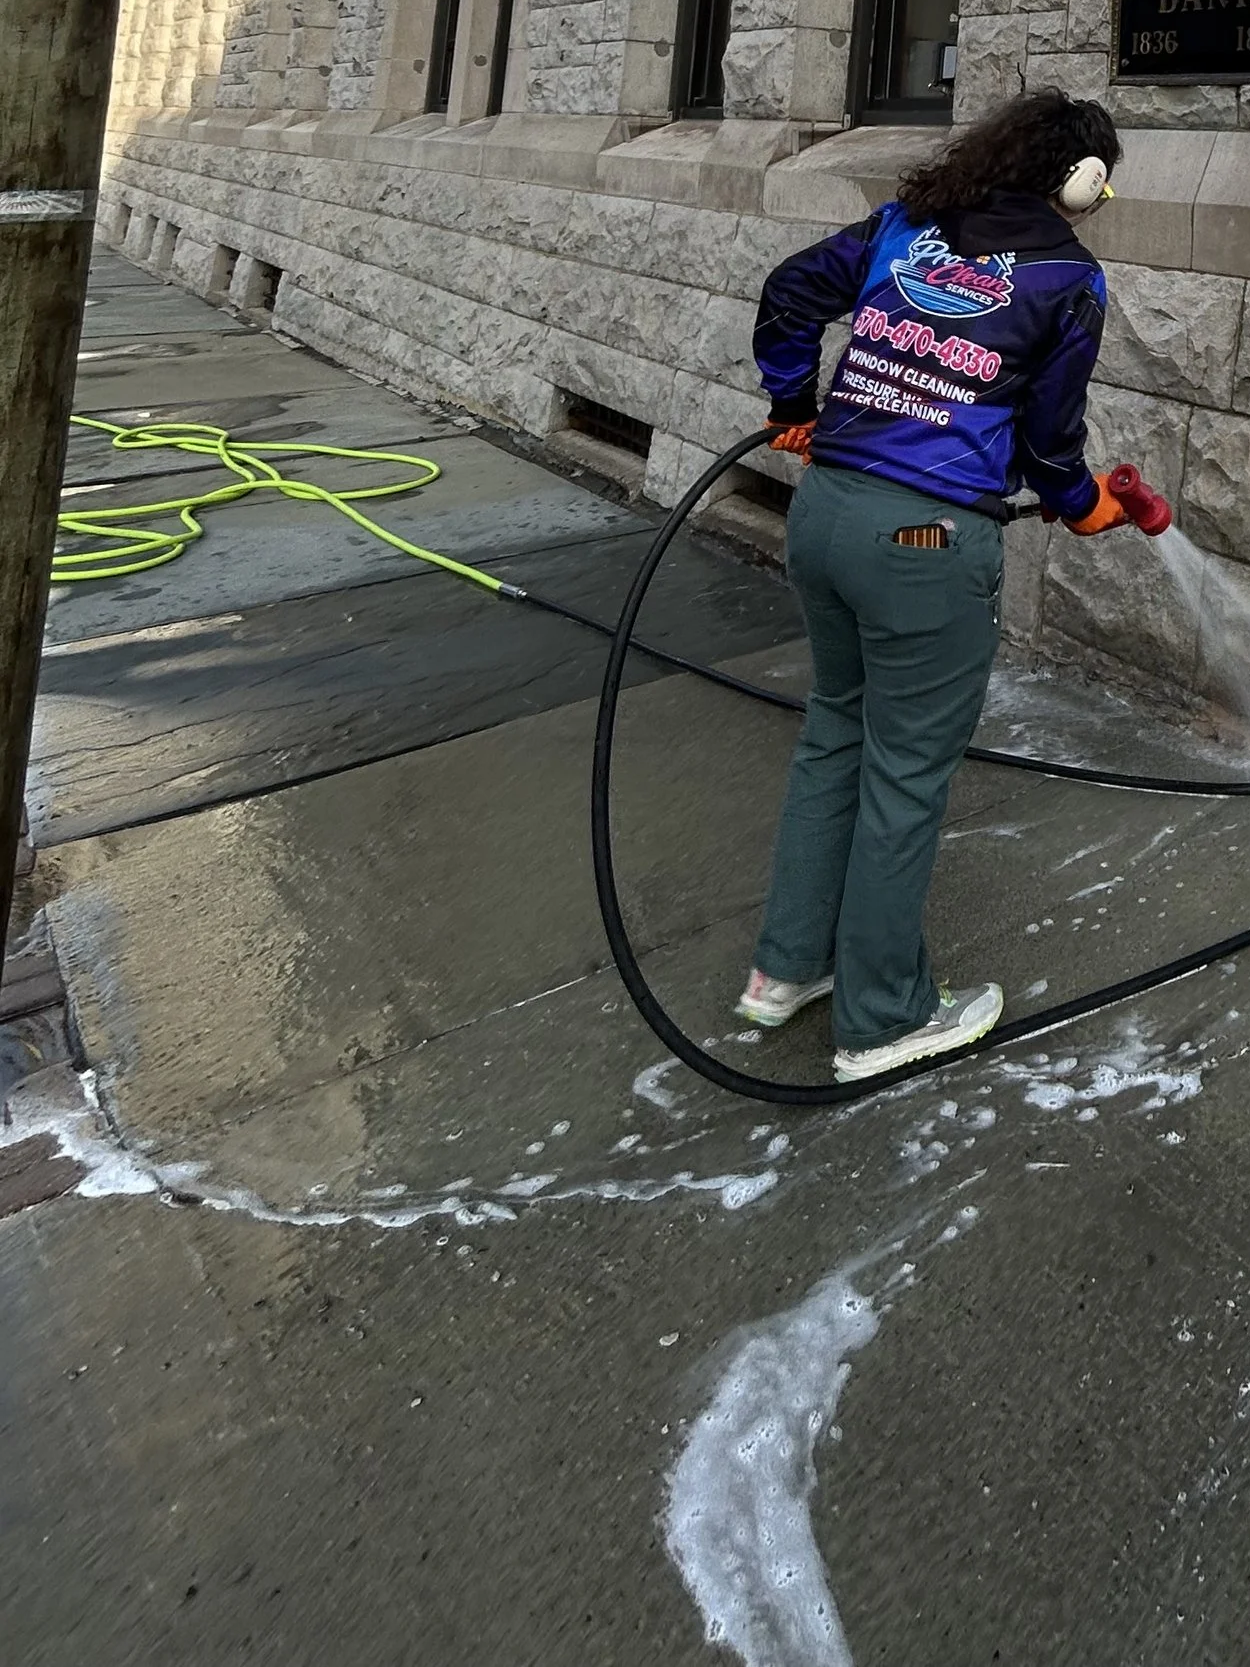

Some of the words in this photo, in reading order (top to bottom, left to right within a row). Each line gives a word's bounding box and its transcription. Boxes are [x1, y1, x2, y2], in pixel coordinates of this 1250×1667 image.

[1132, 31, 1178, 55] 1836
[910, 240, 964, 266] Pro
[926, 263, 1006, 292] Clean
[945, 283, 994, 305] SERVICES
[848, 348, 905, 378] WINDOW
[904, 368, 976, 405] CLEANING
[875, 396, 951, 426] CLEANING
